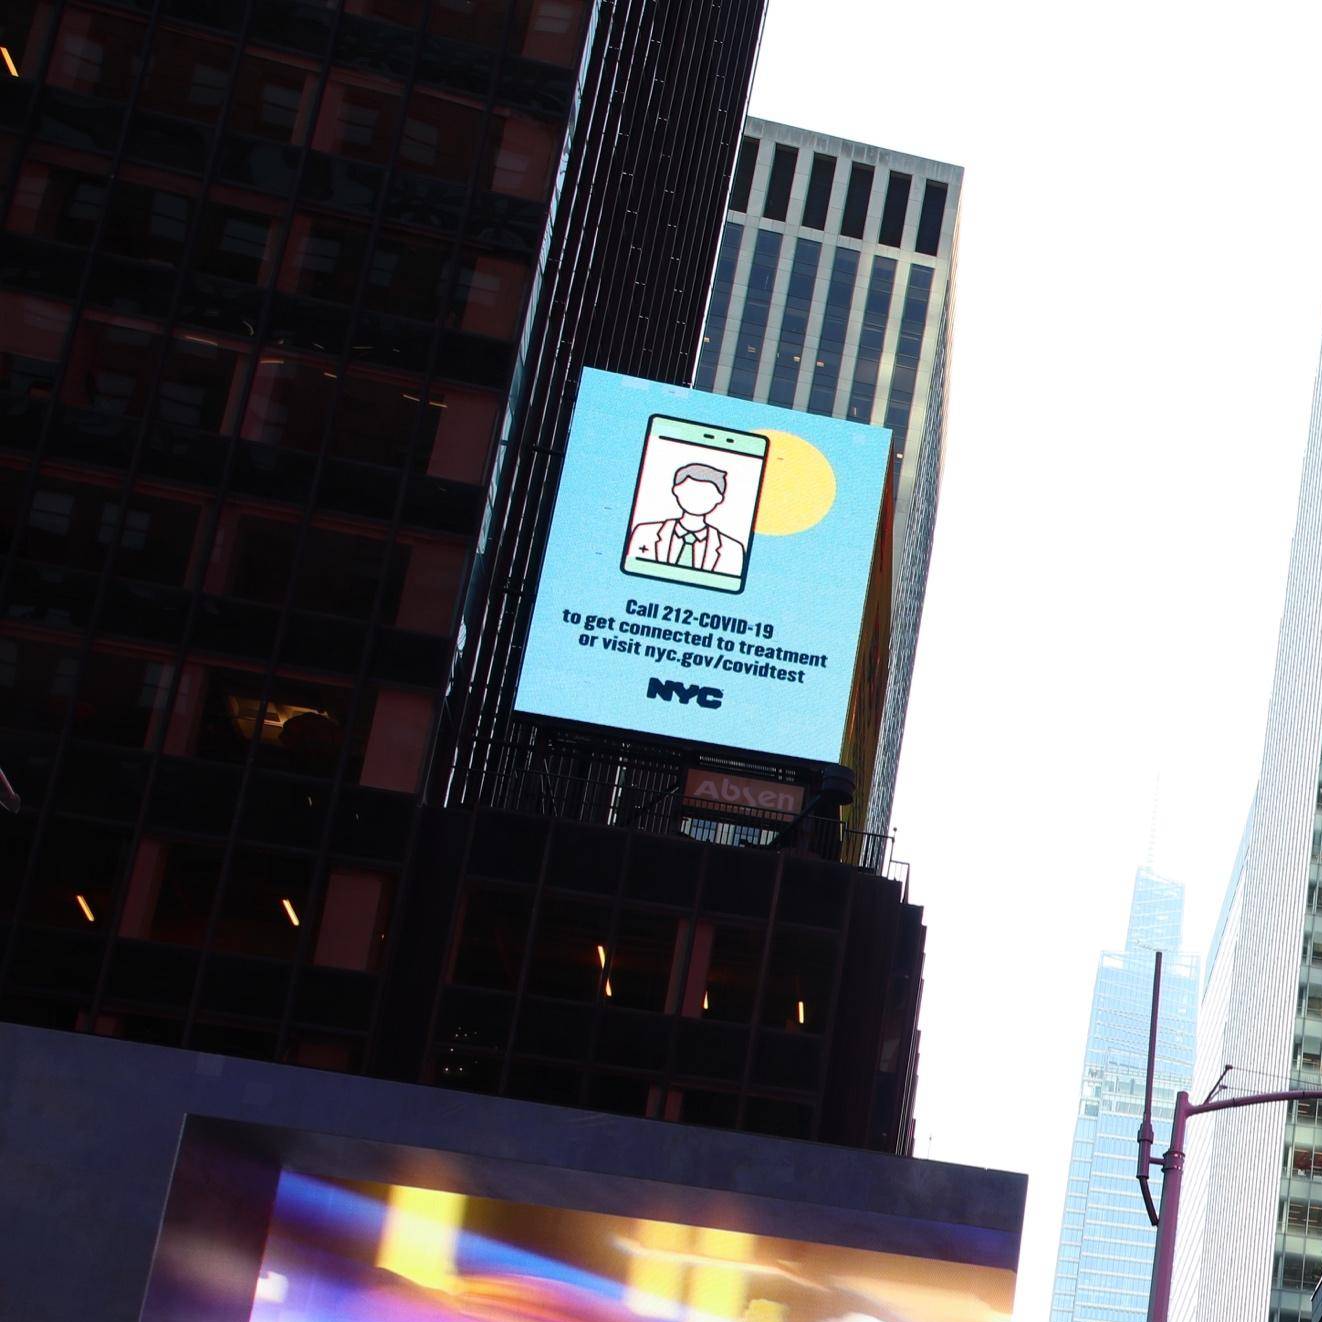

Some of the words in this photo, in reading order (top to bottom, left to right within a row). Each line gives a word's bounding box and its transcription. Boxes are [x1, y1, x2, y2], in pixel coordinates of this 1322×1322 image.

[562, 608, 581, 624] to
[584, 614, 615, 631] get
[619, 619, 713, 648] connected
[716, 636, 735, 652] to
[739, 640, 828, 668] treatment
[625, 599, 659, 619] Call
[662, 605, 774, 639] 212-COVID-19
[578, 633, 598, 646] or
[602, 635, 641, 656] visit
[644, 644, 805, 683] nyc.gov/covidtest
[646, 677, 723, 709] NYC
